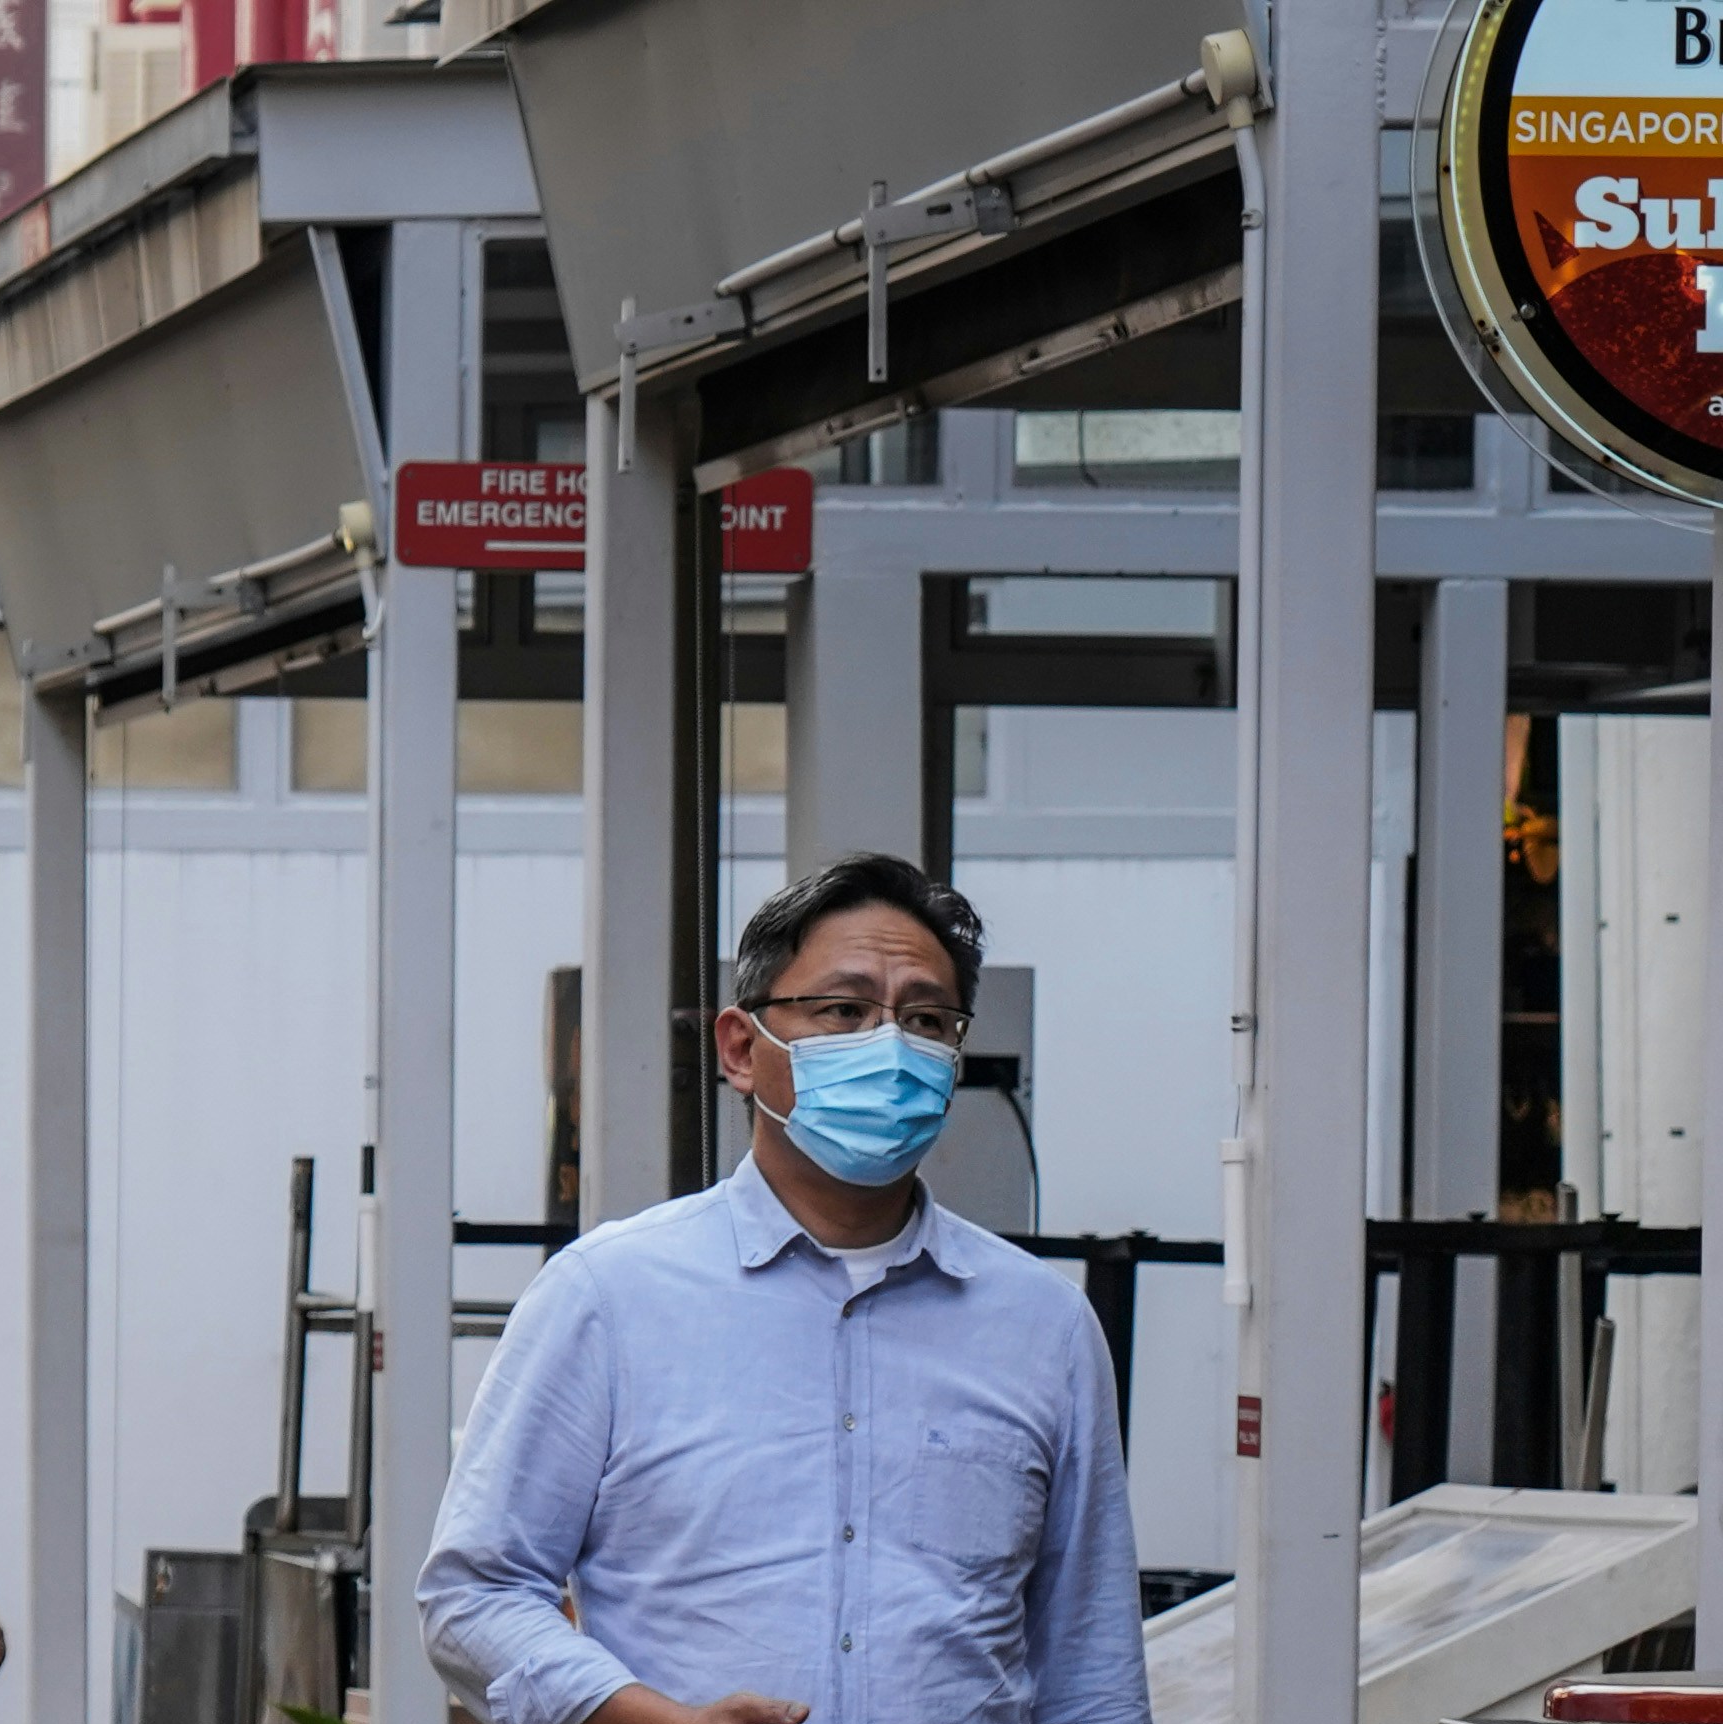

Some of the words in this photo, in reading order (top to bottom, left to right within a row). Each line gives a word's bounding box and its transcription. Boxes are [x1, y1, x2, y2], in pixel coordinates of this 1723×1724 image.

[1675, 7, 1723, 68] B
[1515, 110, 1723, 144] SINGAPOR
[481, 470, 546, 495] FIRE
[417, 501, 586, 528] EMERGENC
[720, 505, 787, 531] OINT
